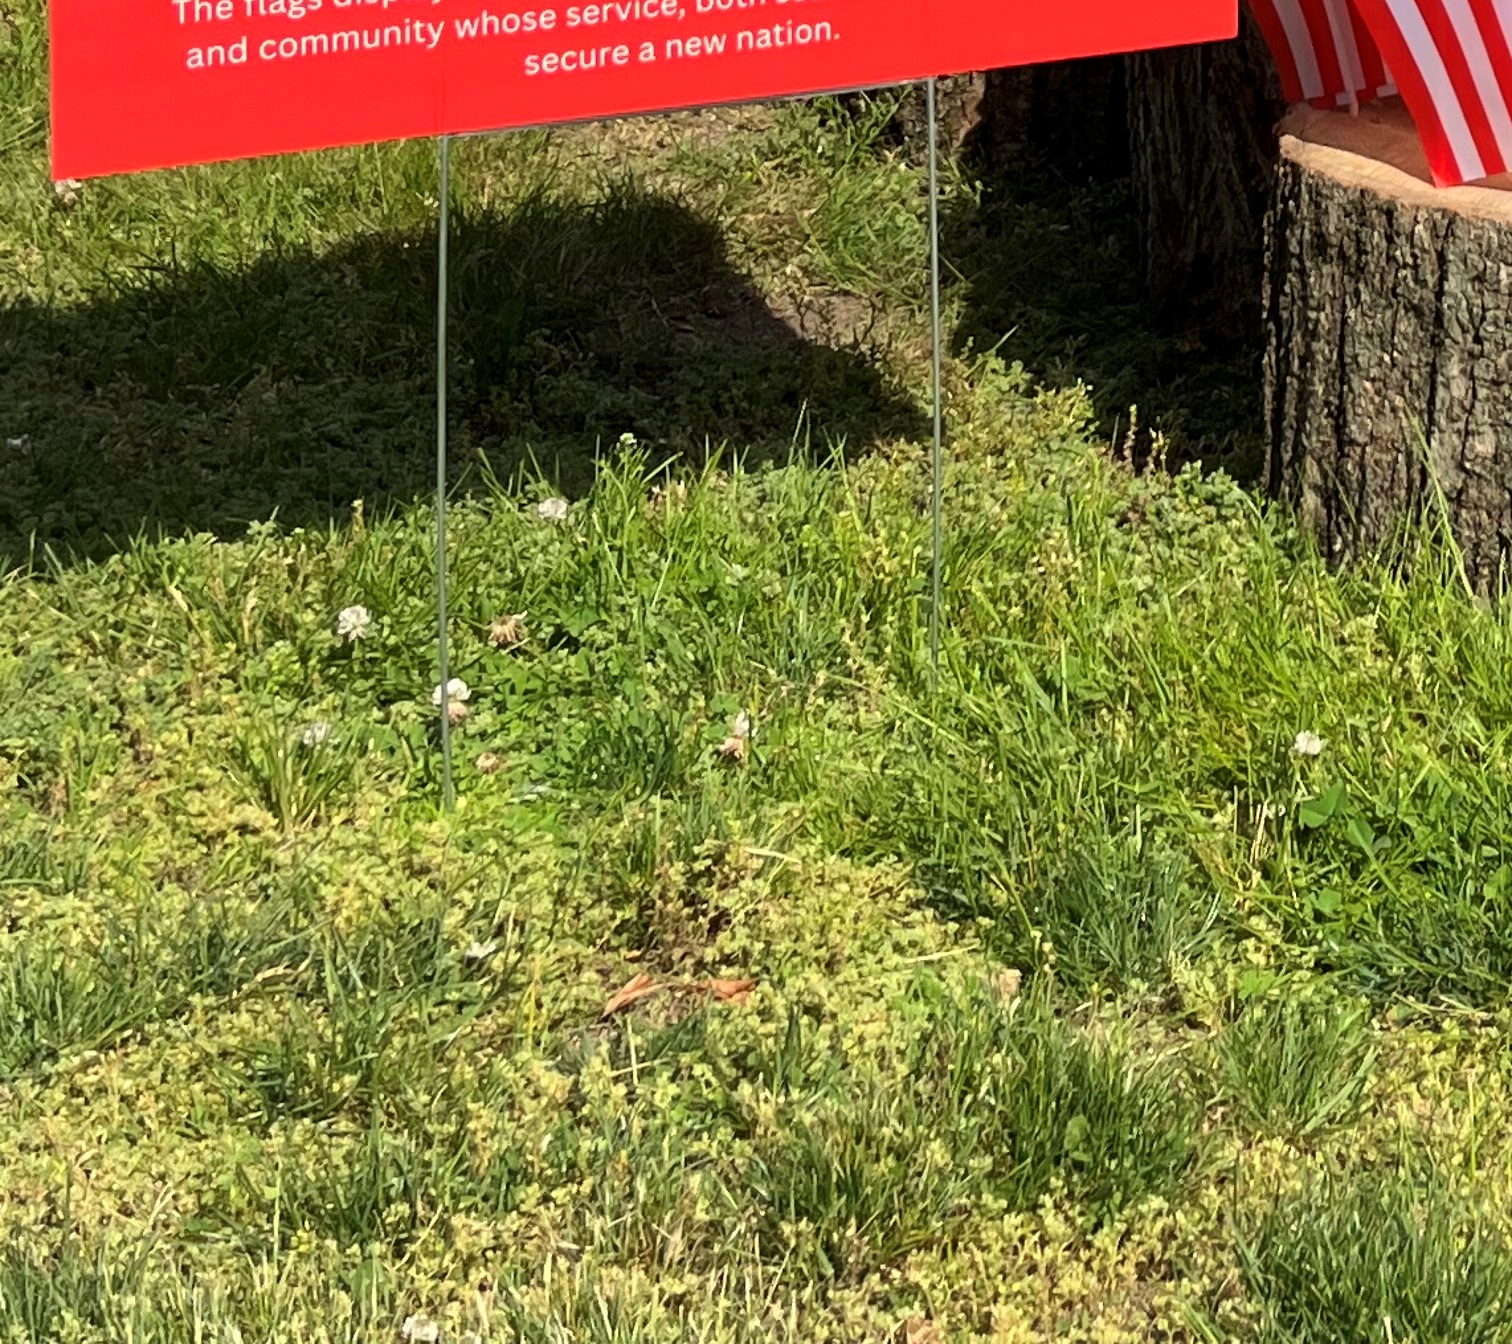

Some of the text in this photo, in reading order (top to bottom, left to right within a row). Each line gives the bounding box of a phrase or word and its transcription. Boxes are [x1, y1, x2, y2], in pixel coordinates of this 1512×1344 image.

[186, 35, 248, 69] and
[259, 18, 445, 60] community
[455, 9, 557, 39] whose
[525, 19, 840, 76] secure a new nation.
